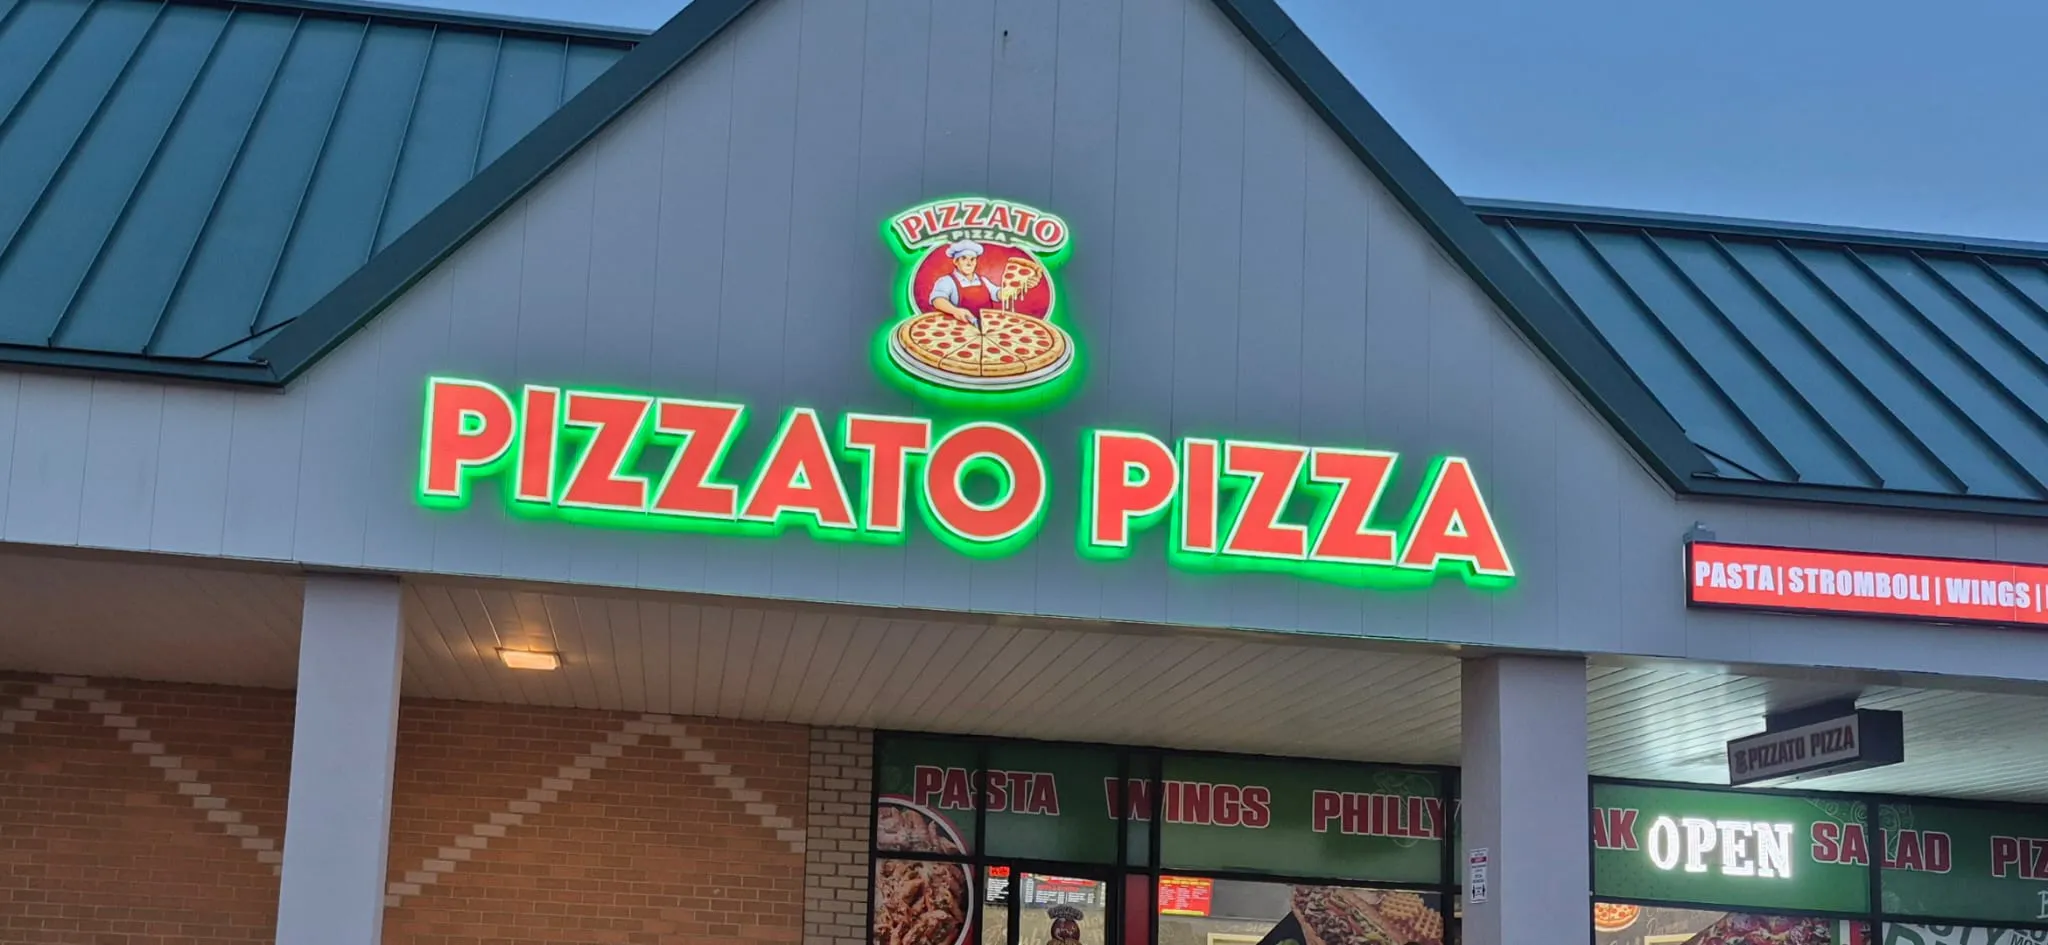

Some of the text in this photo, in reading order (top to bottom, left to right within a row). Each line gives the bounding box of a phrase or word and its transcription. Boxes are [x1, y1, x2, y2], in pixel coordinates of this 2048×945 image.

[898, 202, 1064, 246] PIZZATO
[951, 229, 1008, 242] PIZZA
[423, 376, 1516, 577] PIZZATO PIZZA
[1695, 560, 2030, 609] PASTA STROMBOLI WINGS
[1747, 725, 1855, 771] PIZZATO PIZZA
[913, 765, 1060, 816] PASTA
[1104, 777, 1271, 829] WINGS
[1312, 790, 1461, 840] PHILLY
[1592, 807, 1640, 851] AK
[1811, 820, 1951, 874] SALAD
[1648, 815, 1794, 879] OPEN
